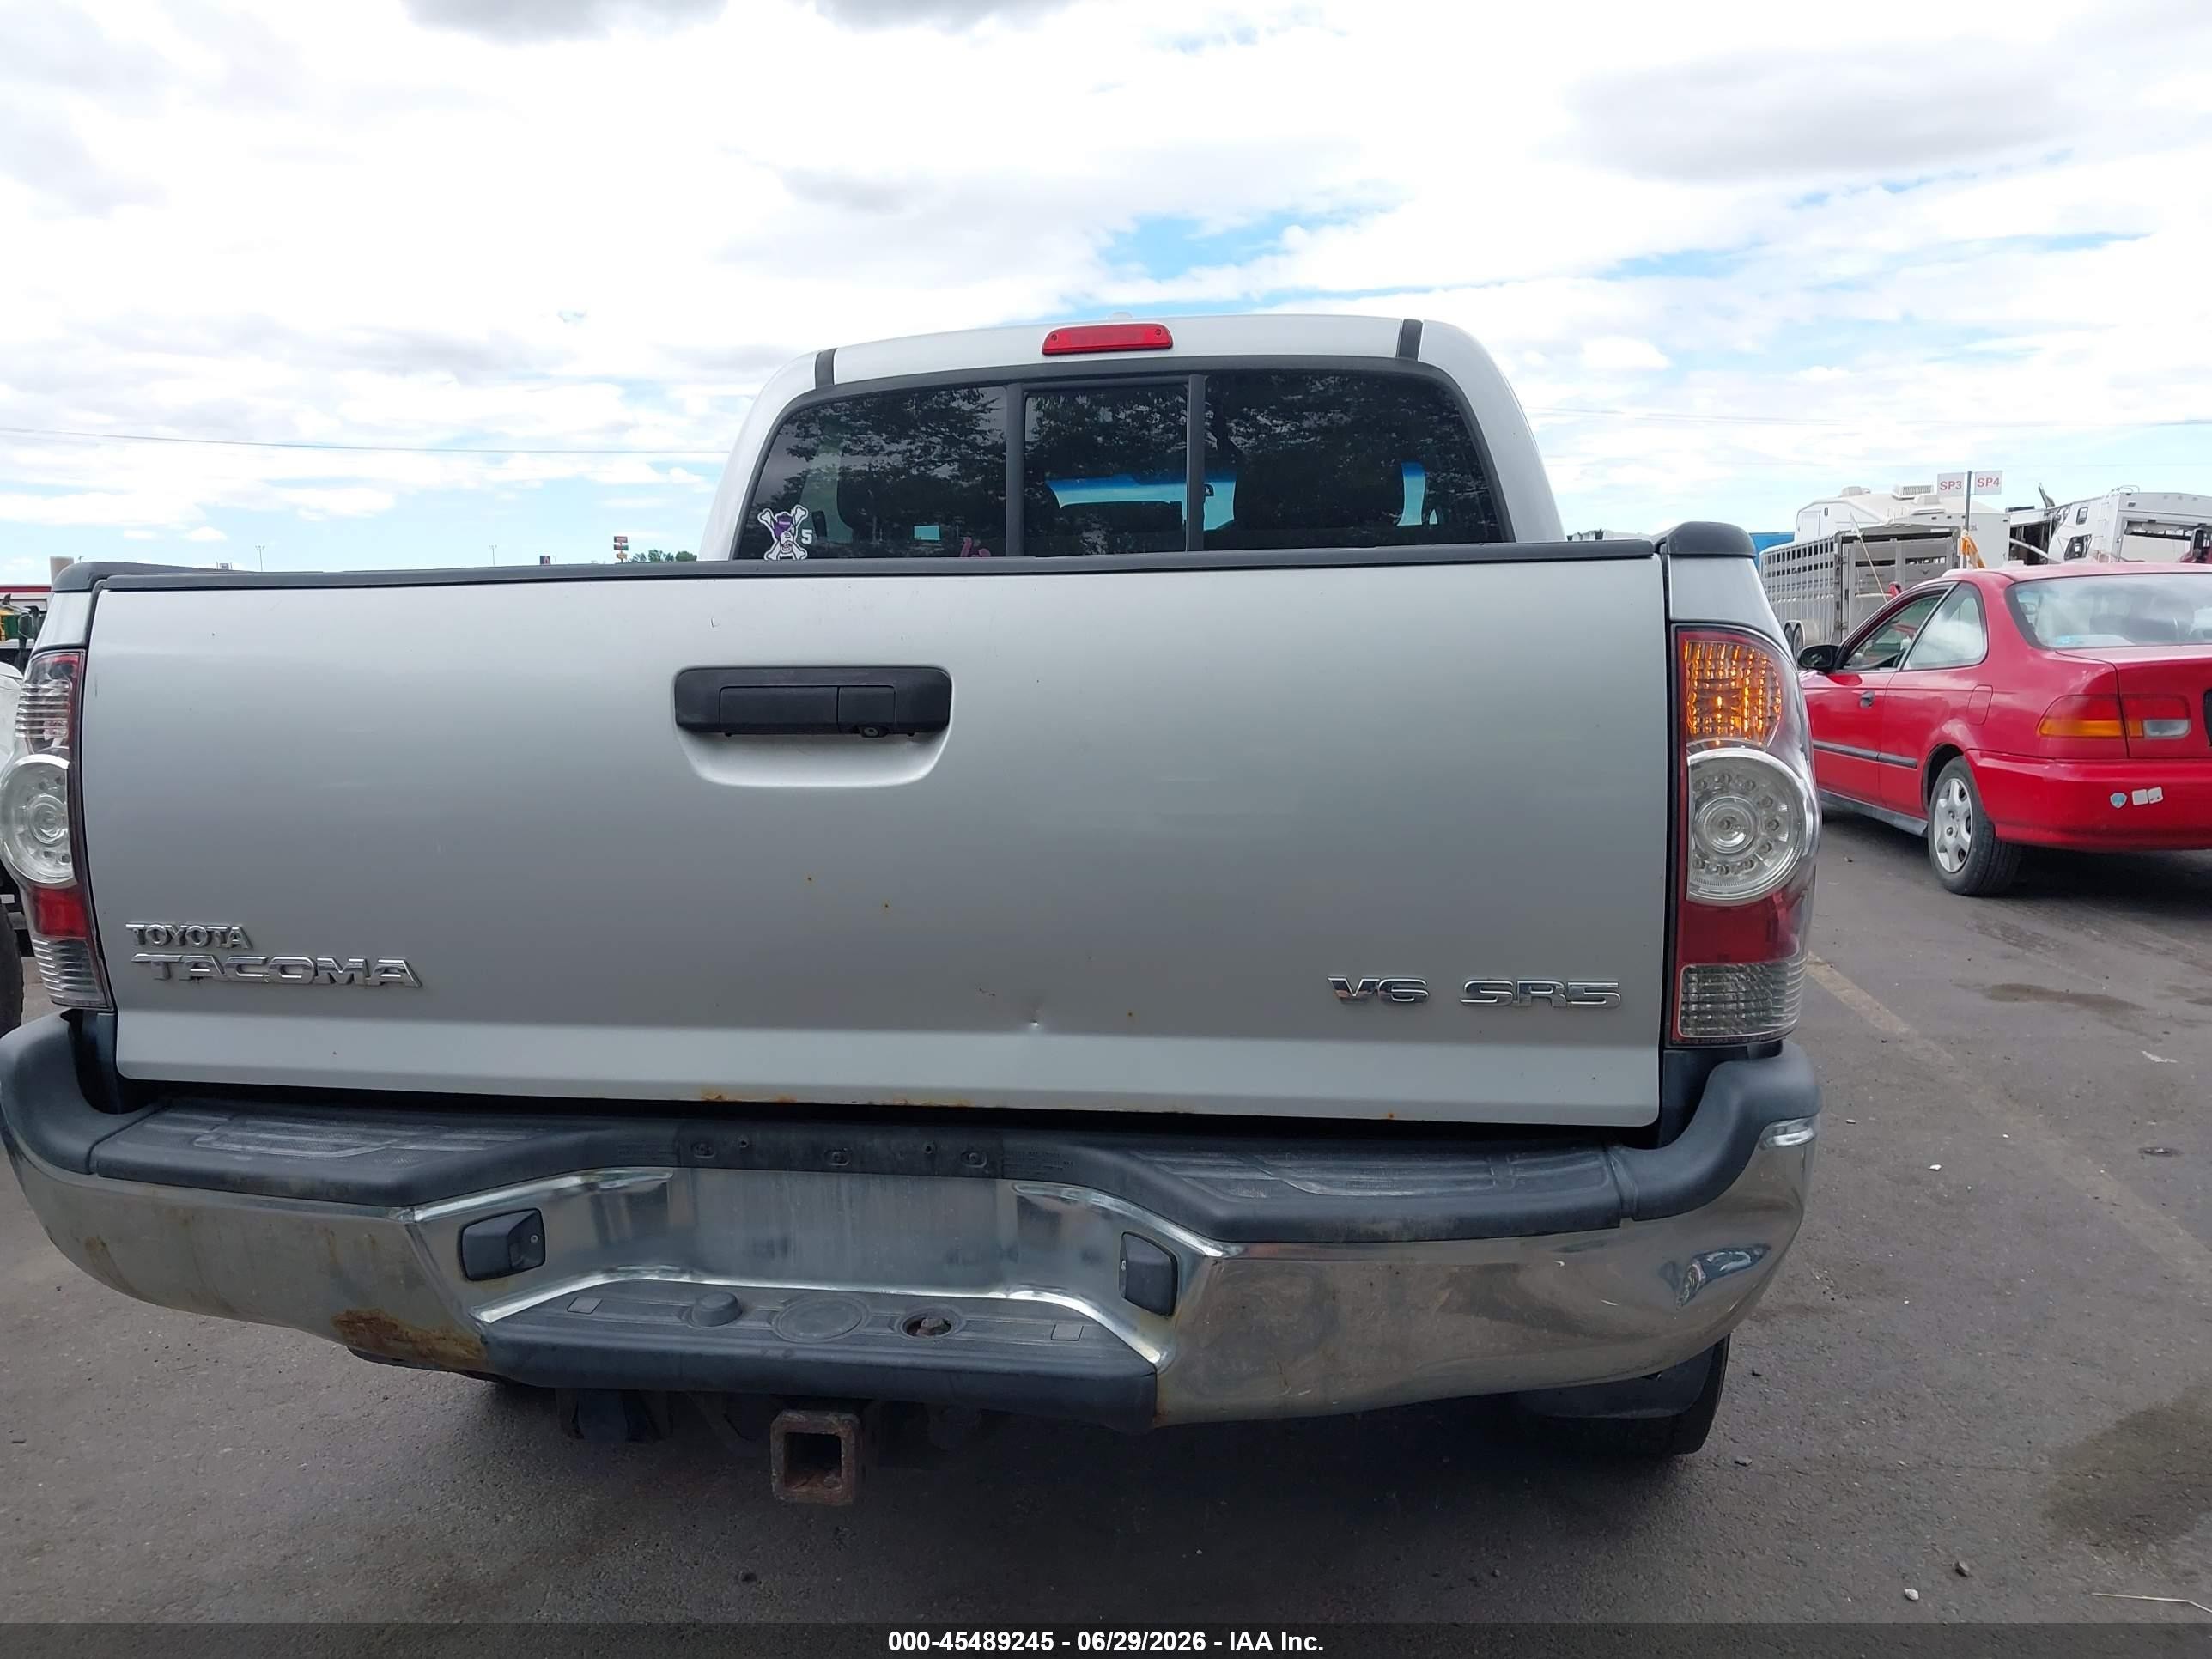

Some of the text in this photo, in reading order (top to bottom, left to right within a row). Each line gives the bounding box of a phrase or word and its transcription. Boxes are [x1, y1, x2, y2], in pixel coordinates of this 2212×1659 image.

[1940, 480, 1962, 491] SP3
[1977, 477, 2000, 488] SP4
[801, 528, 812, 544] 5
[125, 922, 253, 950] TOYOTA
[131, 952, 424, 988] TACOMA
[1327, 975, 1621, 1009] V6 SR5
